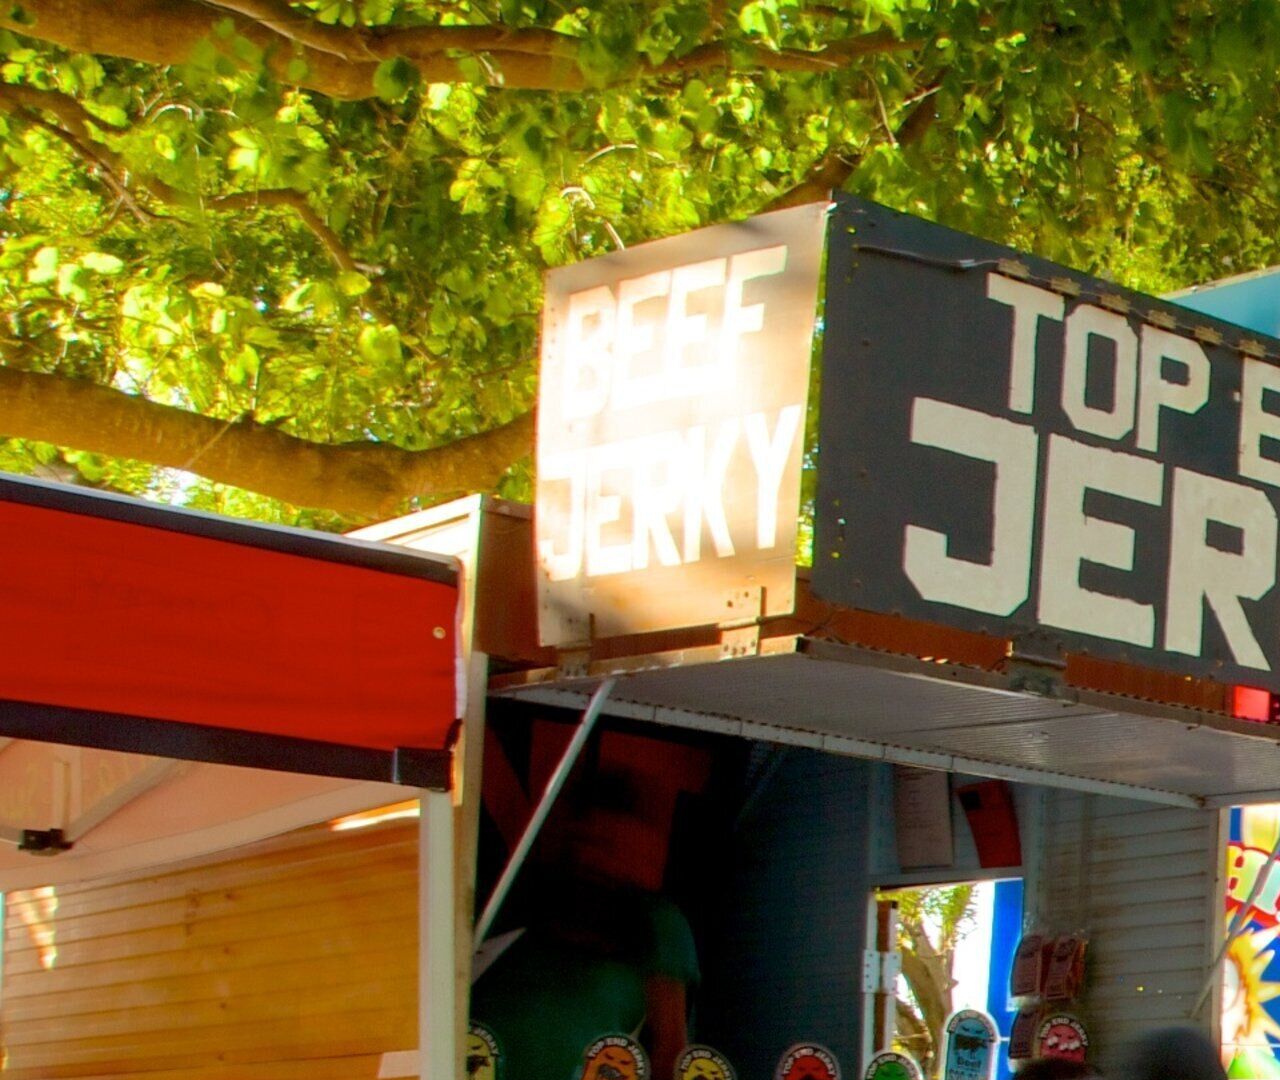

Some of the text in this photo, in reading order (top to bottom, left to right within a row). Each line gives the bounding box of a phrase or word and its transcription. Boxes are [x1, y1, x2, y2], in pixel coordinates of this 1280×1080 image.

[558, 243, 788, 424] BEEF
[985, 271, 1211, 452] TOP
[538, 403, 802, 581] JERKY
